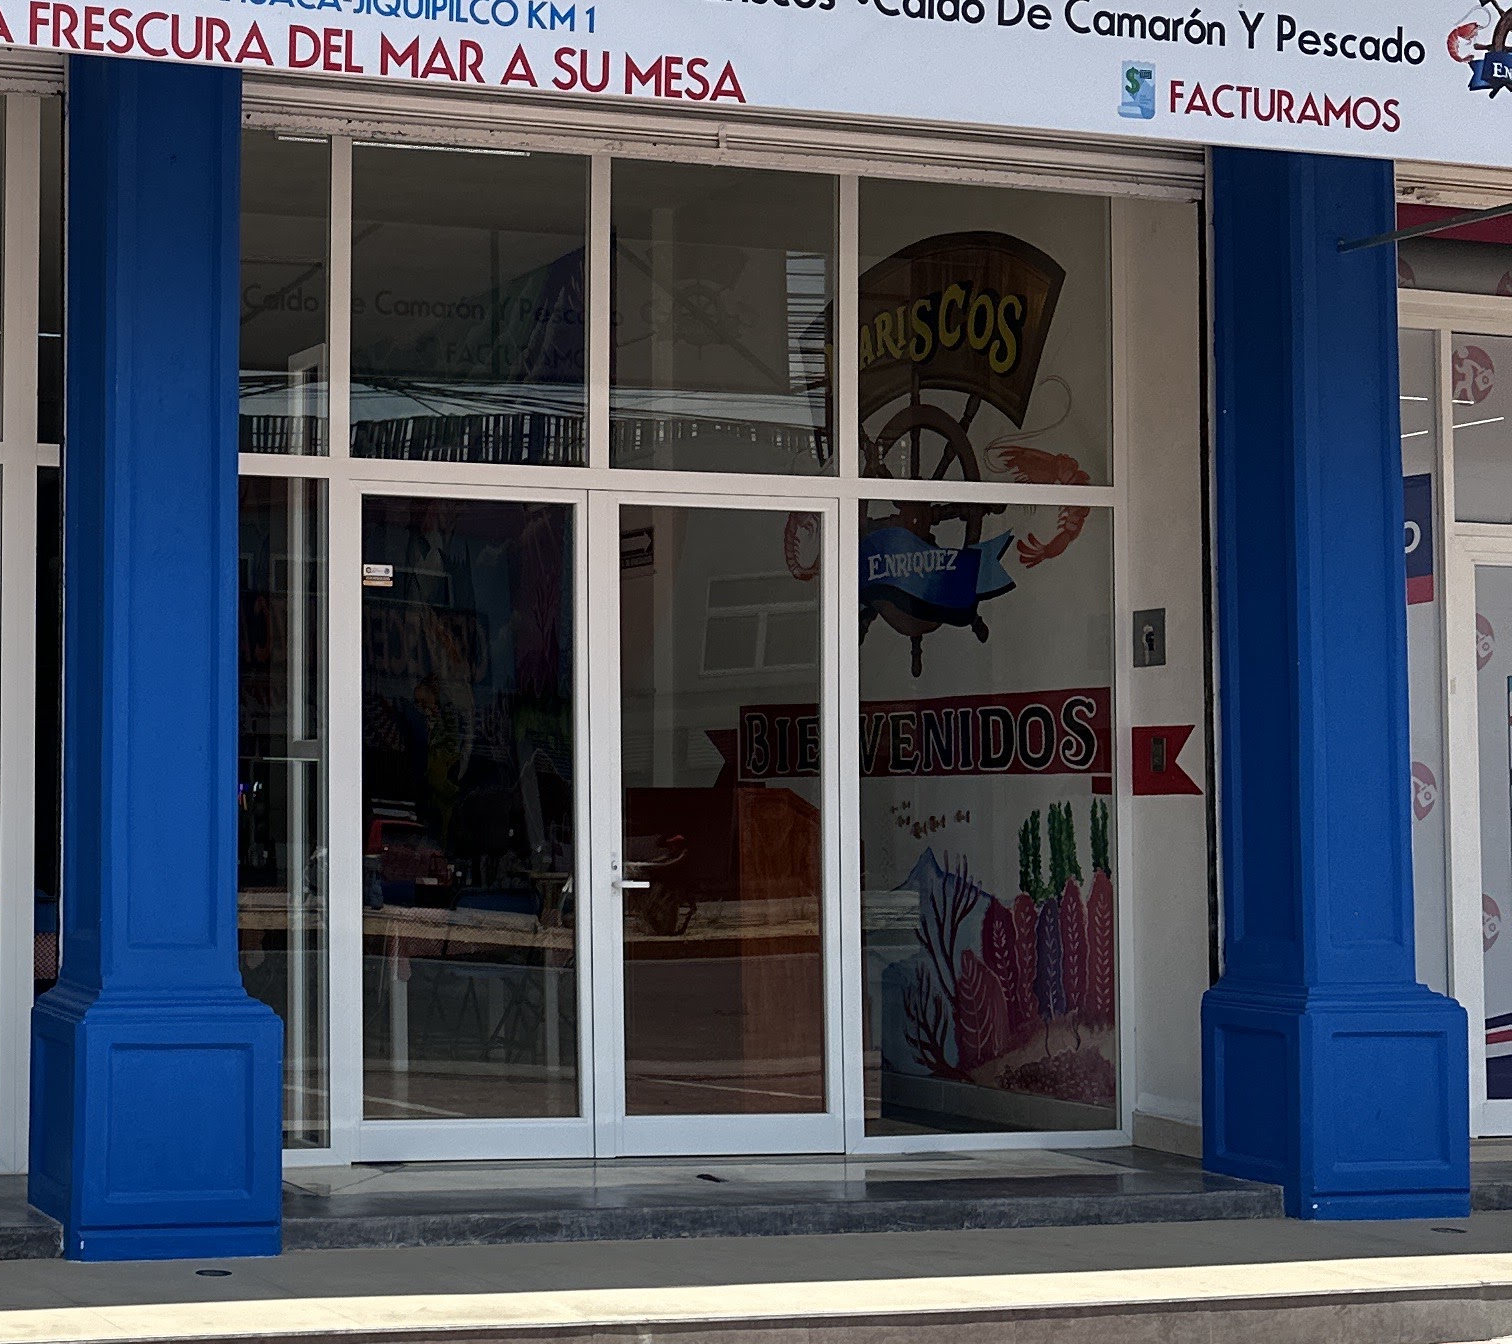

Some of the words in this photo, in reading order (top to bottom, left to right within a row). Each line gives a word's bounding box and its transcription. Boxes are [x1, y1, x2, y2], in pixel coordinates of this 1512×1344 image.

[584, 3, 596, 33] 1
[1240, 10, 1264, 50] Y
[1277, 16, 1426, 66] Pescado
[29, 1, 272, 67] FRESCURA
[287, 26, 363, 74] DEL
[380, 34, 485, 84] MAR
[499, 43, 539, 87] A
[552, 48, 610, 93] SU
[625, 50, 746, 103] MESA
[1170, 81, 1401, 133] FACTURAMOS
[825, 284, 1022, 373] ARISCOS
[867, 550, 958, 581] ENRIQUEZ
[745, 696, 1097, 775] BIEVENIDOS
